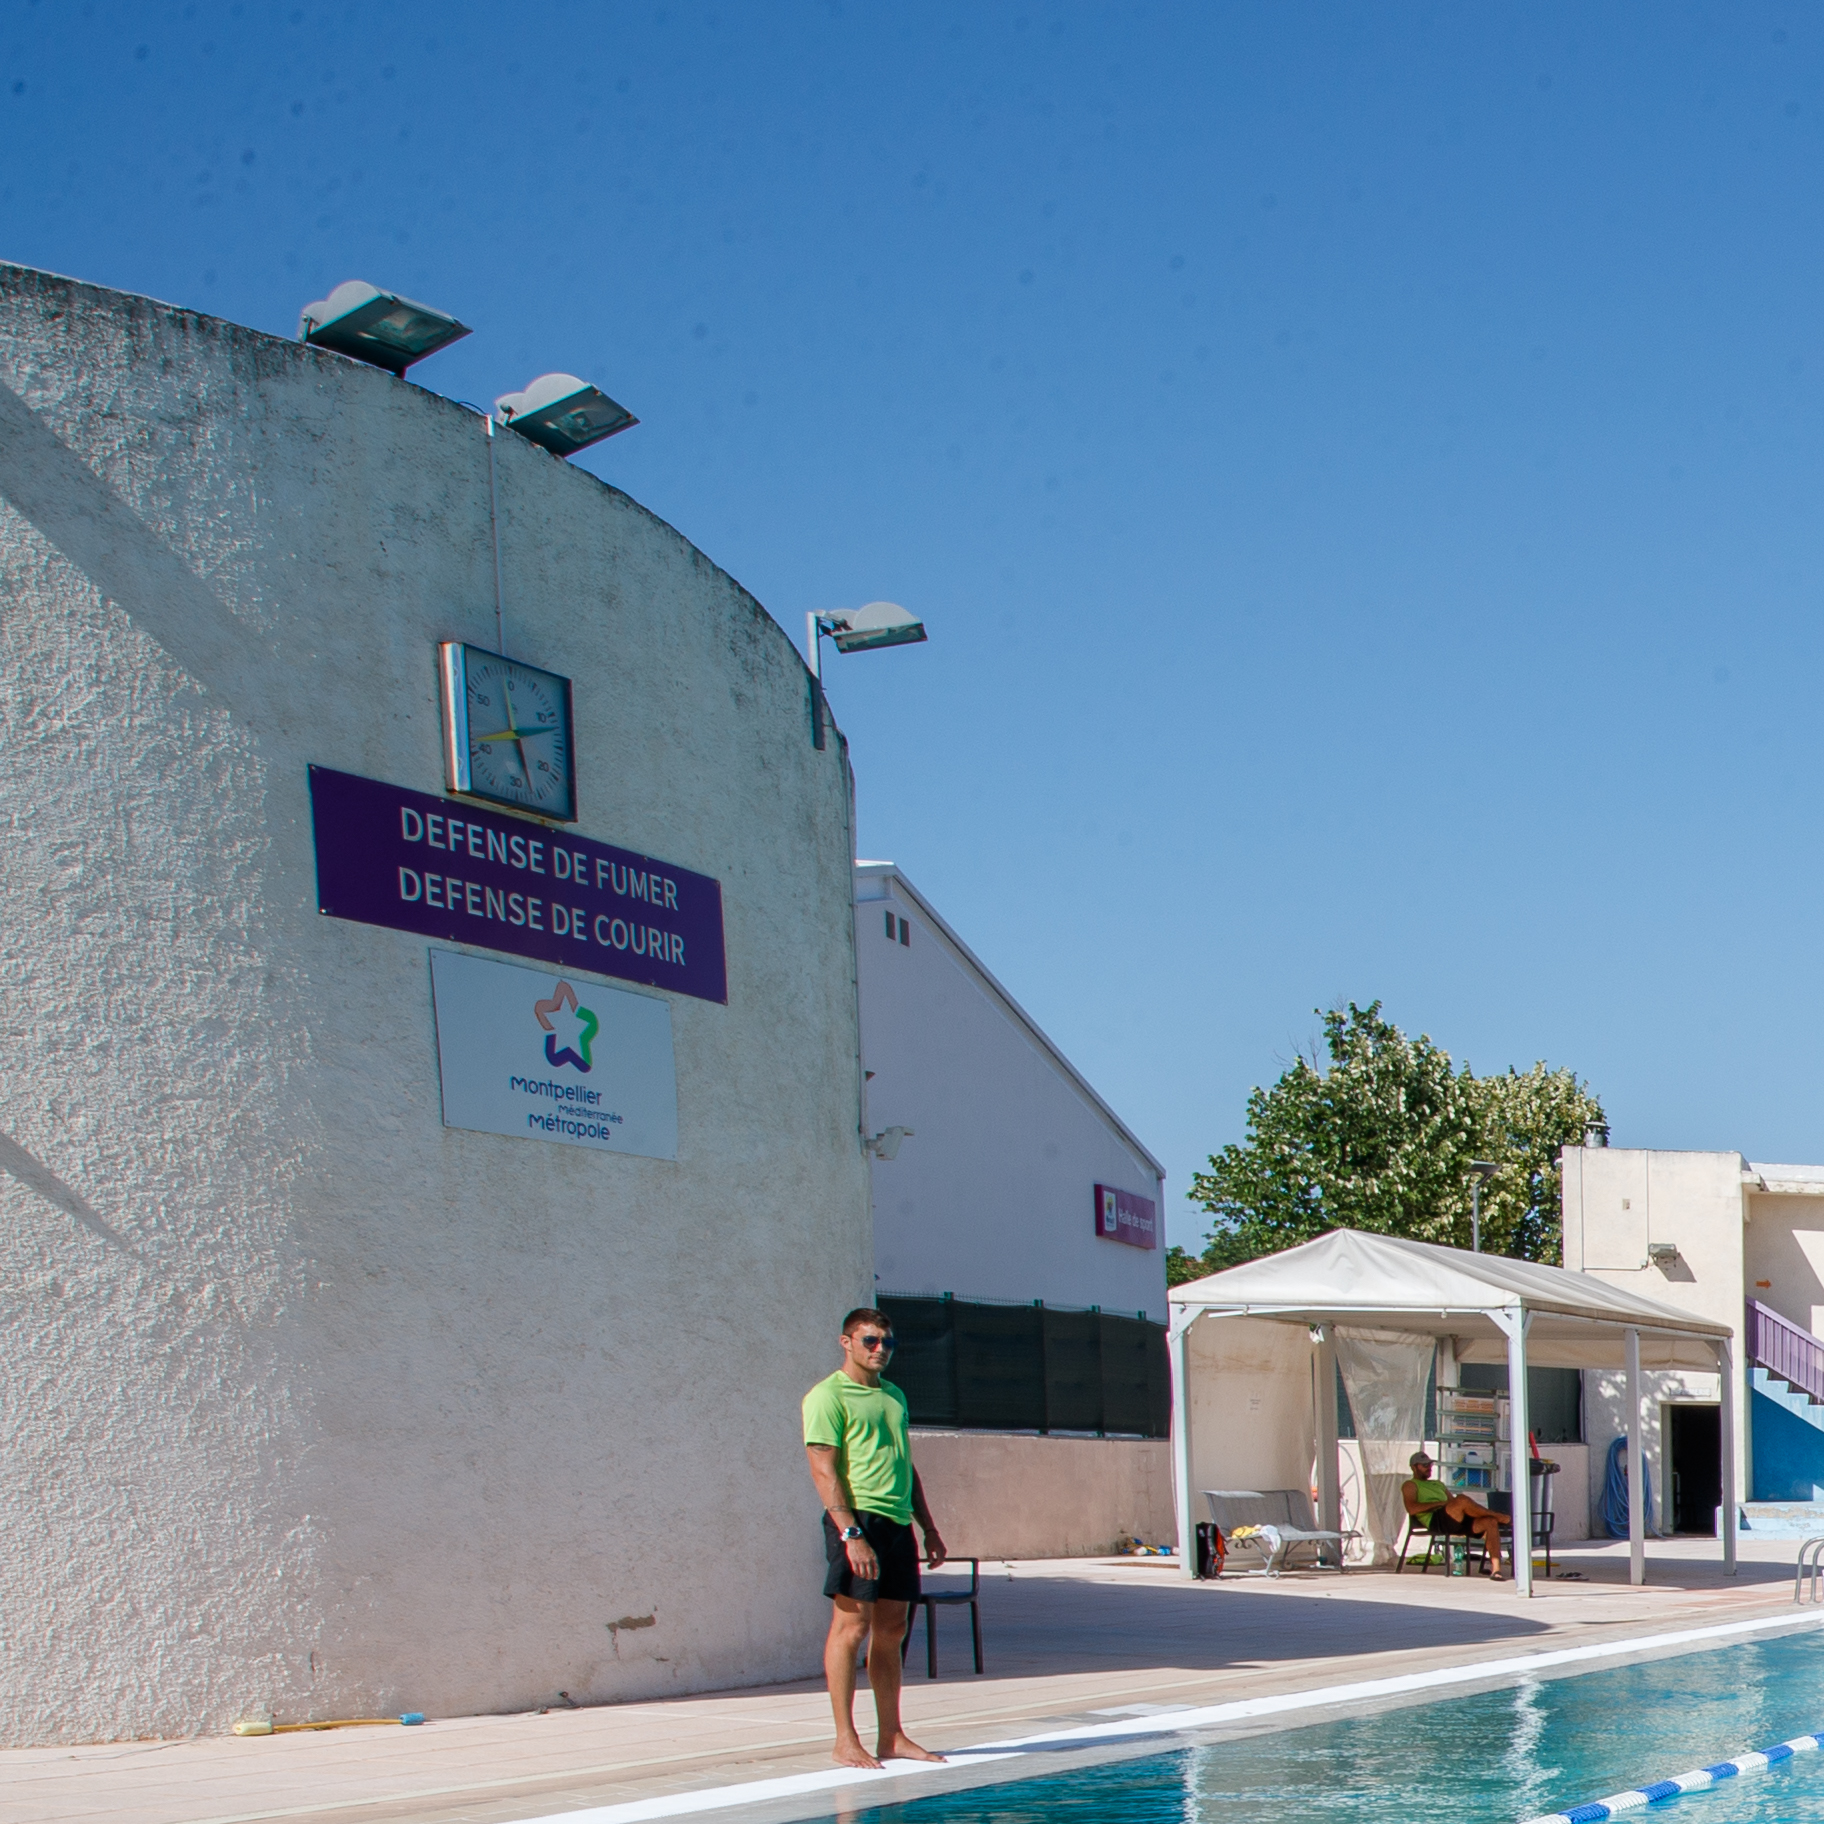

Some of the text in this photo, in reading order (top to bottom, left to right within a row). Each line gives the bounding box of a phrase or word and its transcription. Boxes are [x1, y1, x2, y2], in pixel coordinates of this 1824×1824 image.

[508, 680, 515, 692] 0
[477, 694, 491, 707] 50
[536, 711, 547, 723] 10
[479, 743, 492, 755] 40
[537, 759, 549, 773] 20
[510, 775, 523, 788] 30
[401, 806, 679, 911] DEFENSE DE FUMER
[398, 866, 686, 966] DEFENSE DE COURIR
[510, 1075, 602, 1106] Montpellier
[528, 1112, 611, 1140] Métropole
